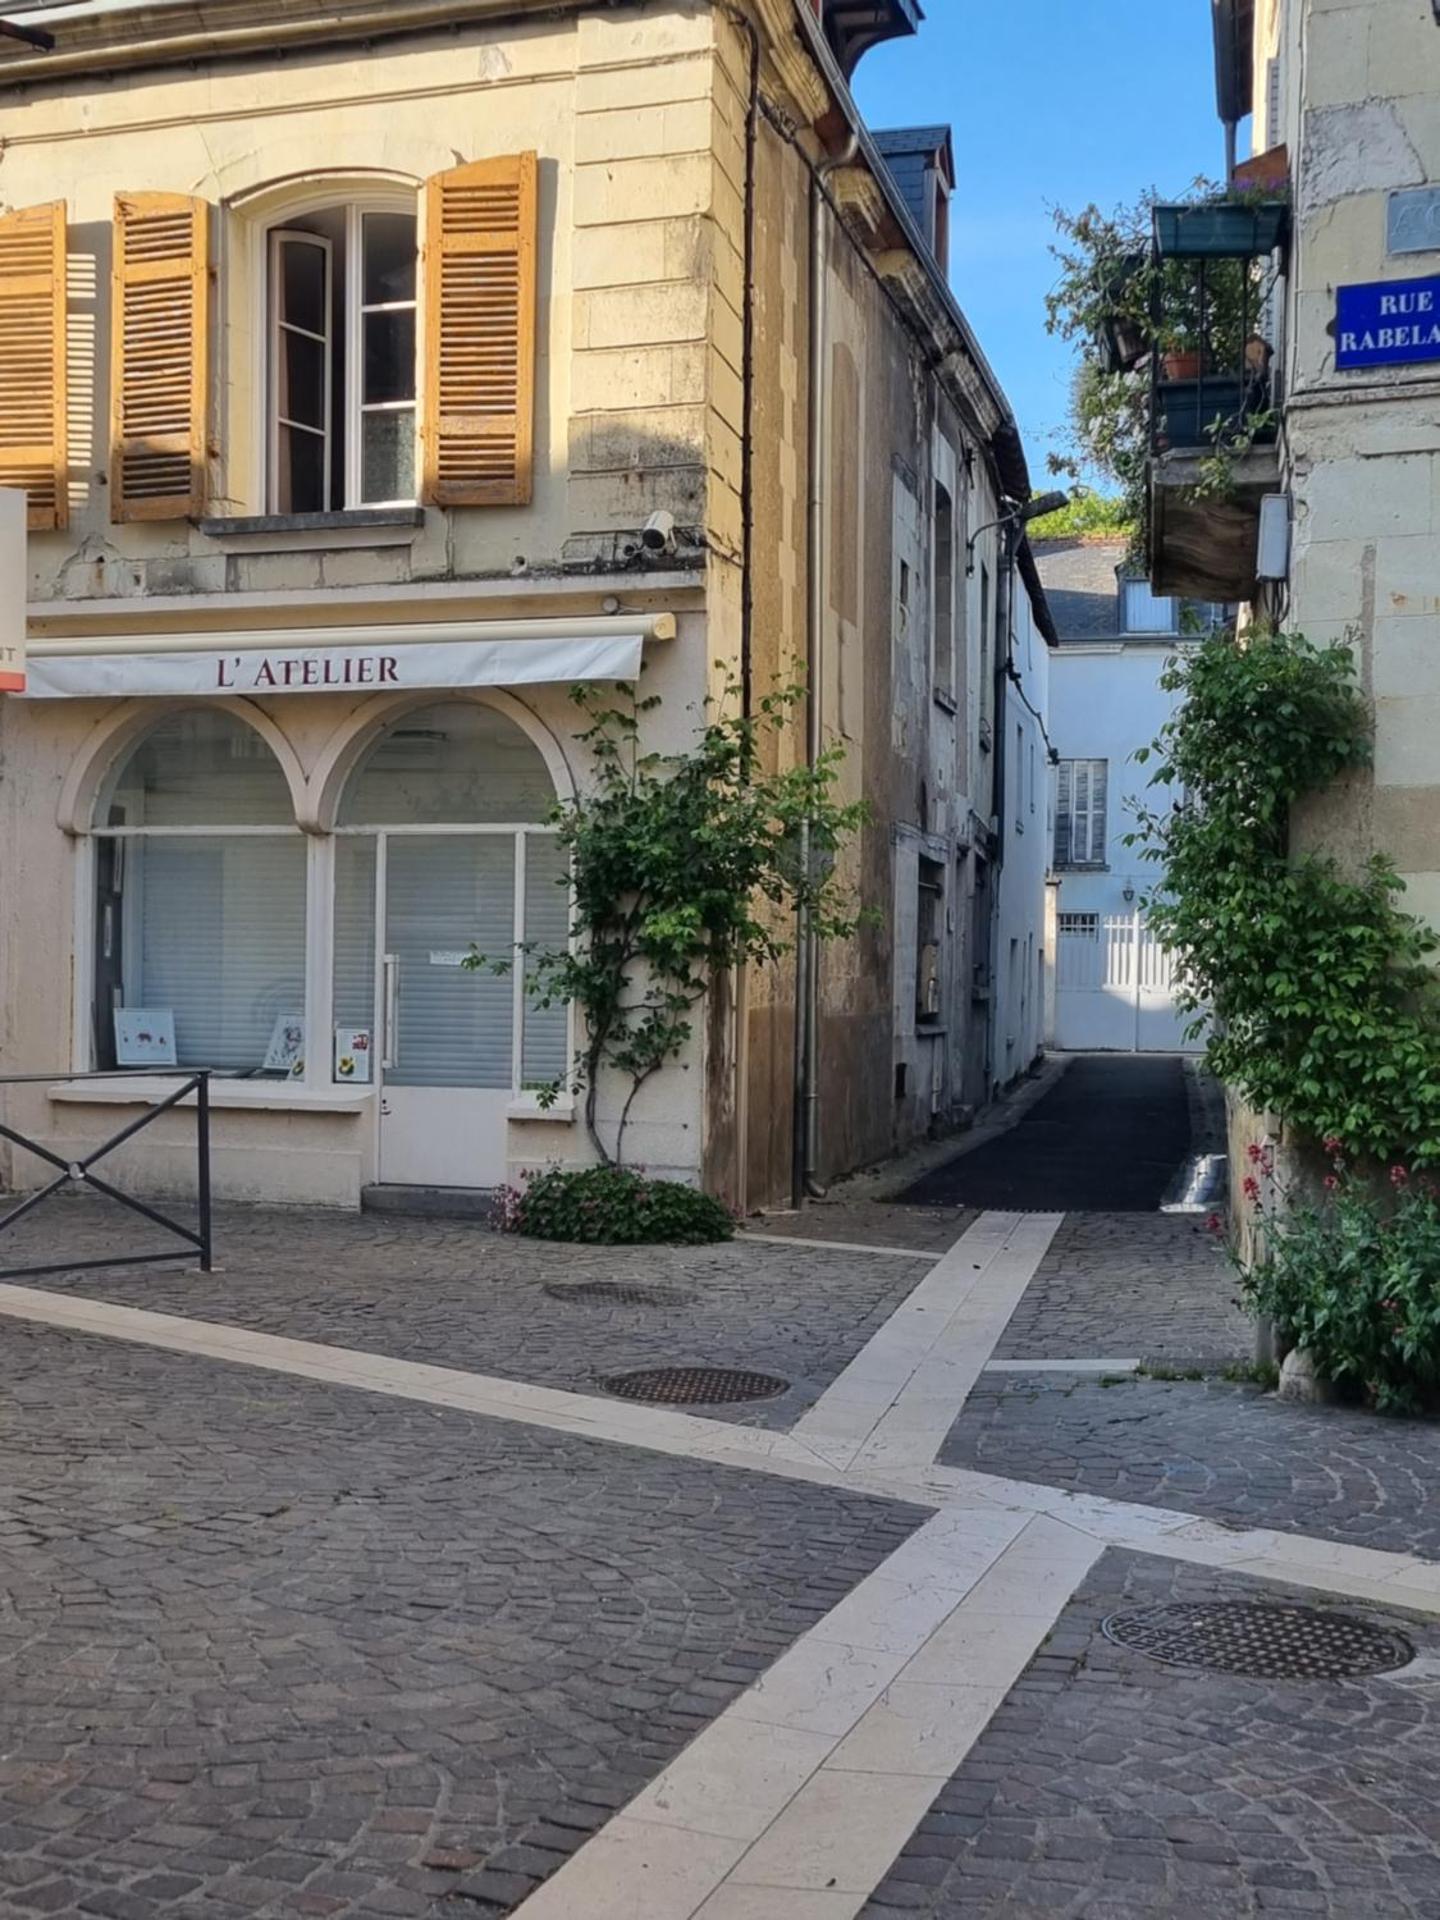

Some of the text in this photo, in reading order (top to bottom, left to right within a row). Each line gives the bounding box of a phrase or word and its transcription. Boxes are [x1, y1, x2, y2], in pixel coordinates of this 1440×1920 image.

[1380, 291, 1433, 316] RUE
[1340, 324, 1440, 352] RABELA
[254, 657, 399, 686] ATELIER
